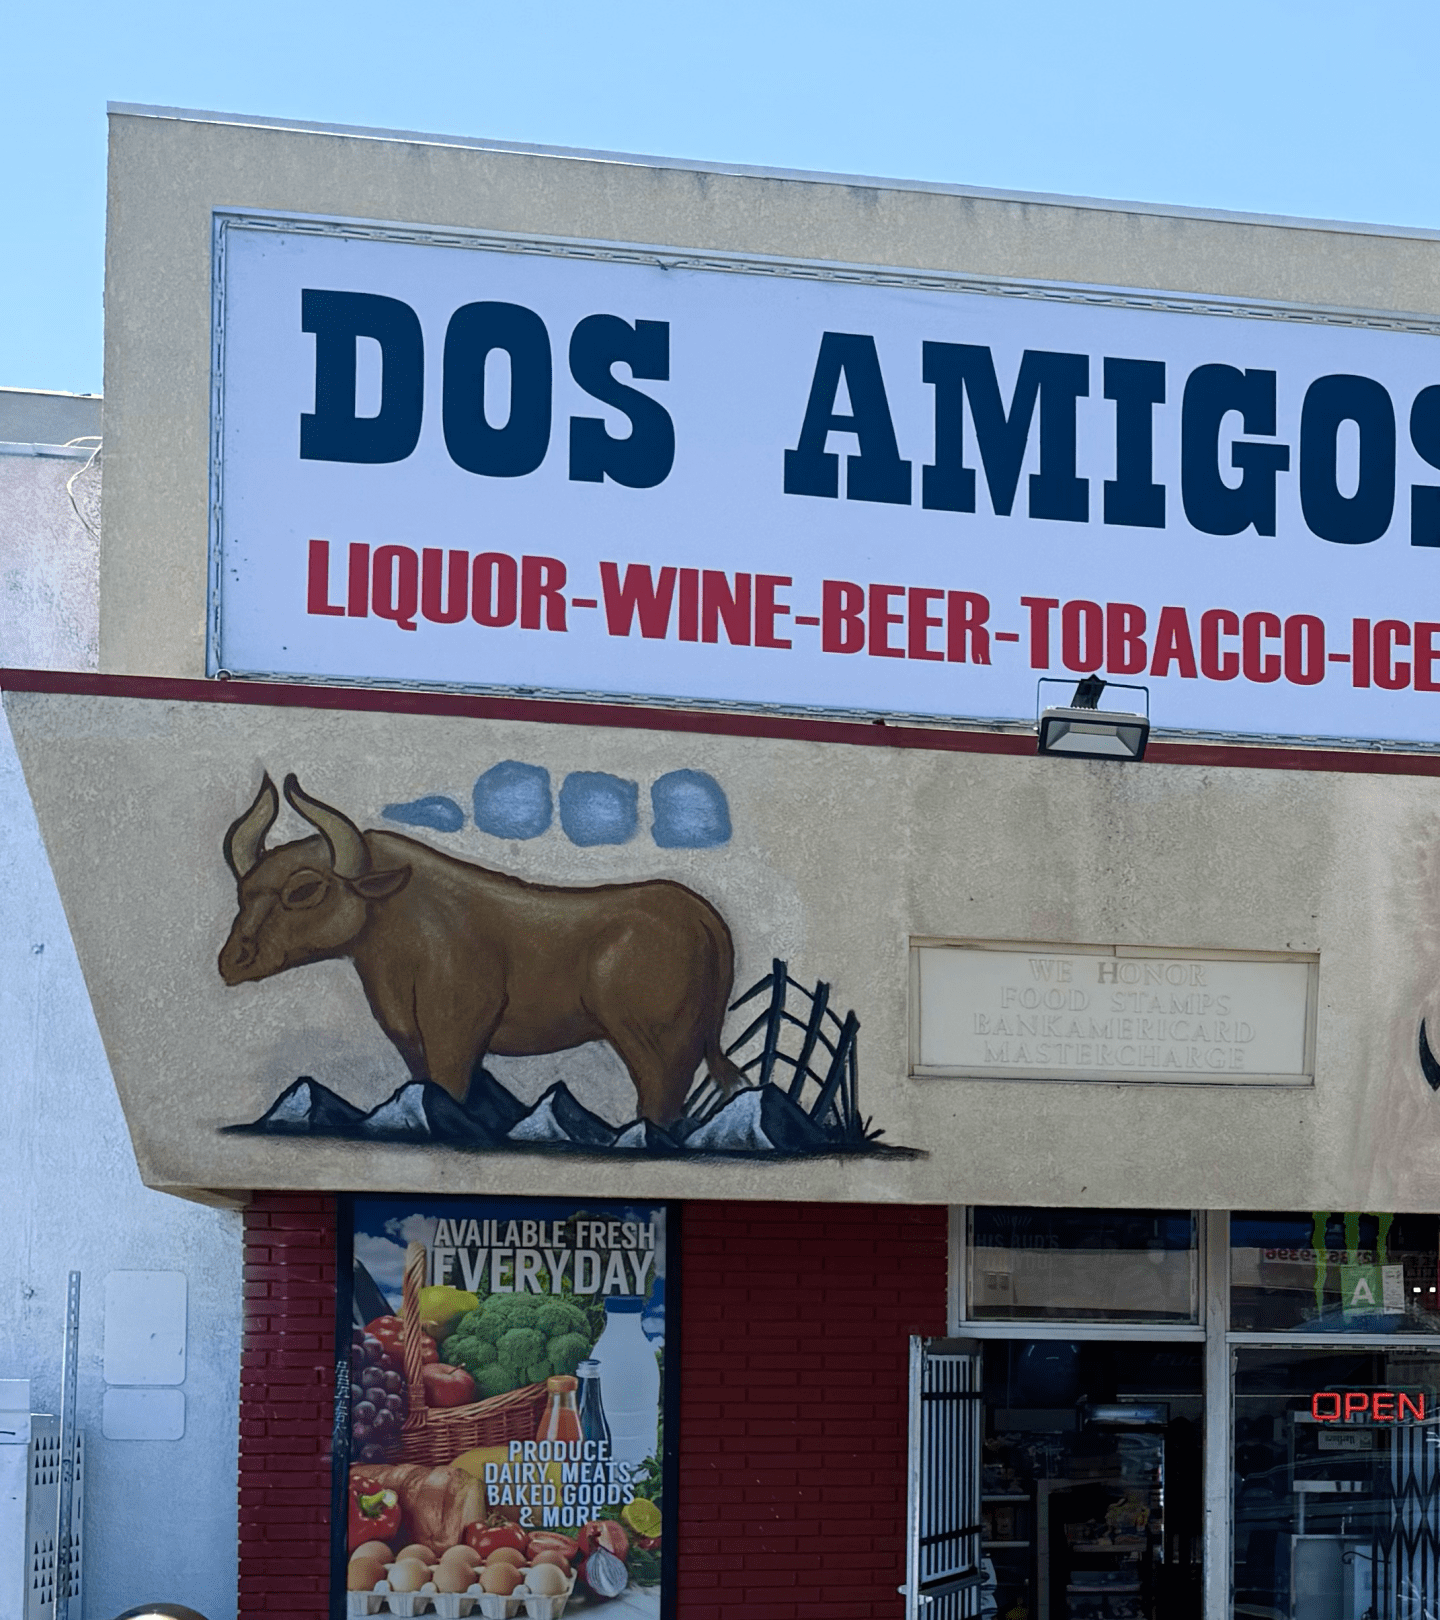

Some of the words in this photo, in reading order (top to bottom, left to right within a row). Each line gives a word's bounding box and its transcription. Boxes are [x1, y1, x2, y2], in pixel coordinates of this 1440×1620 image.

[299, 288, 676, 489] DOS
[1028, 958, 1073, 982] WE
[1097, 961, 1208, 987] HONOR
[1000, 987, 1091, 1012] FOOD
[1111, 990, 1232, 1016] STAMPS
[973, 1012, 1256, 1045] BANKAMERICARD
[983, 1041, 1246, 1070] MASTERCHARGE
[434, 1218, 566, 1248] AVAILABLE
[576, 1221, 655, 1249] FRESH
[433, 1248, 655, 1296] EVERYDAY
[1350, 1277, 1376, 1306] A
[1312, 1392, 1426, 1421] OPEN
[487, 1484, 556, 1506] BAKED
[563, 1484, 635, 1506] GOODS
[519, 1506, 535, 1528] &
